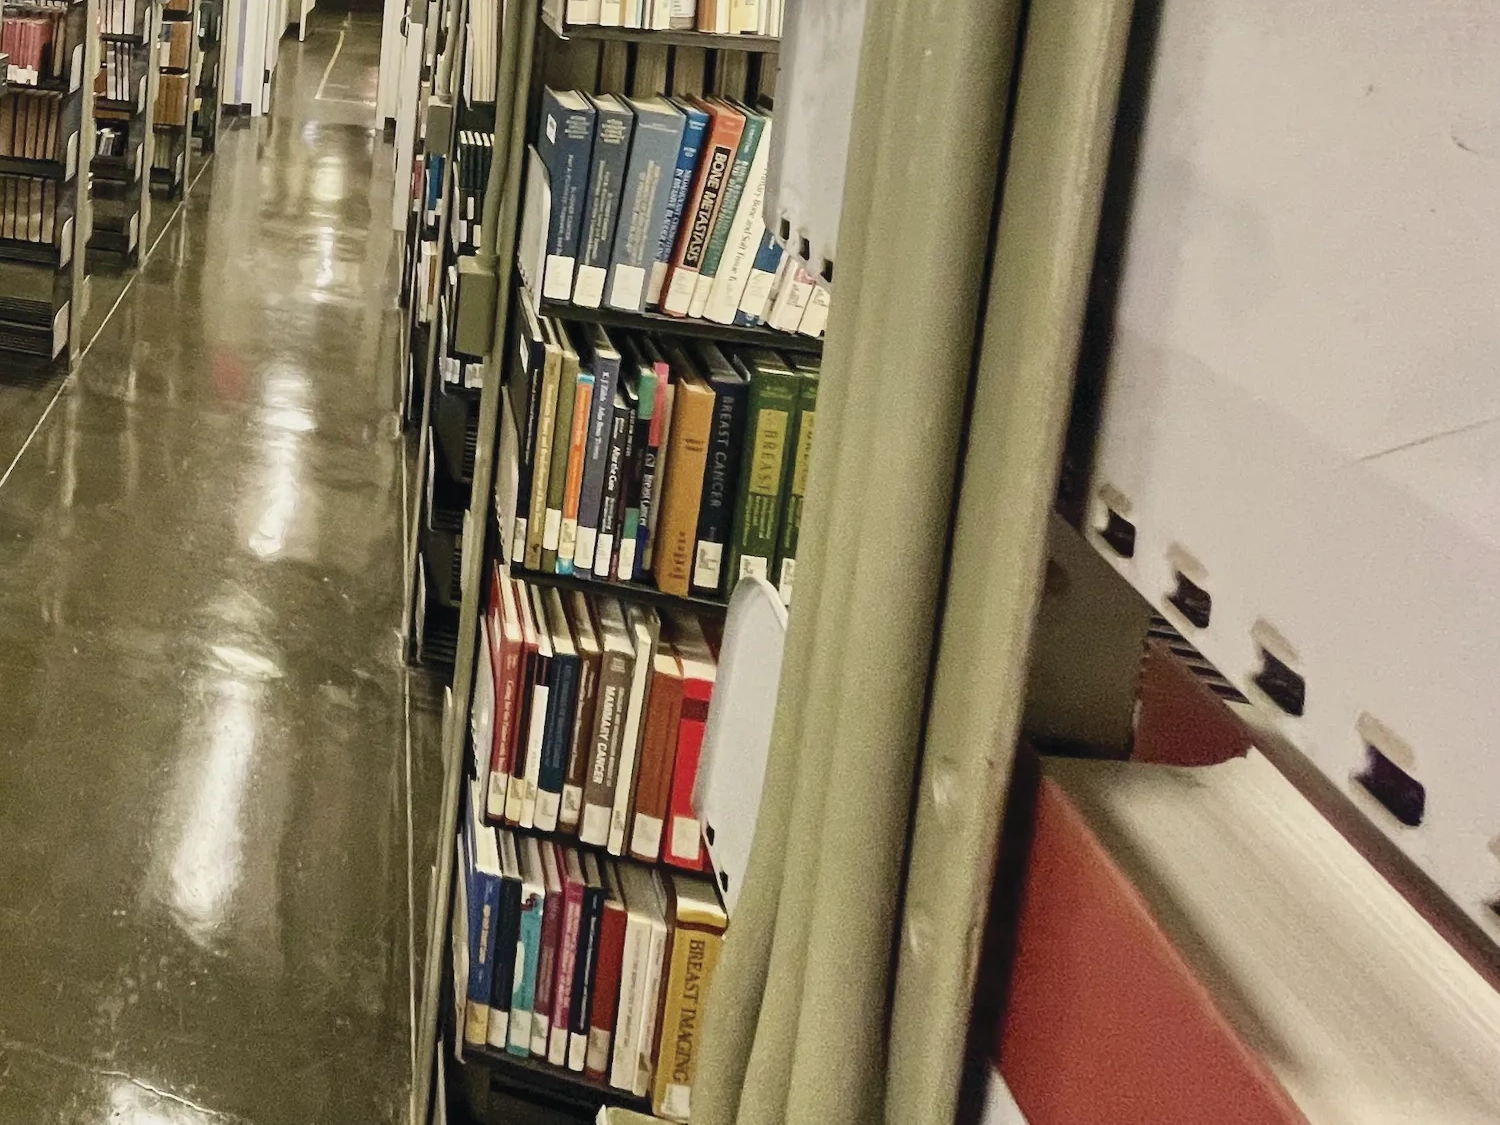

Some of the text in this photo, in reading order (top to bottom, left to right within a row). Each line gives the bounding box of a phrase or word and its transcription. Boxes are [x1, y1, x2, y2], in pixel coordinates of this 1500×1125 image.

[706, 152, 728, 190] BONE
[687, 191, 718, 263] METASTASIS
[708, 396, 735, 508] BREAST CANCER
[592, 685, 616, 785] MAMMARY CANCER
[673, 939, 706, 1082] BREAST IMAGING
